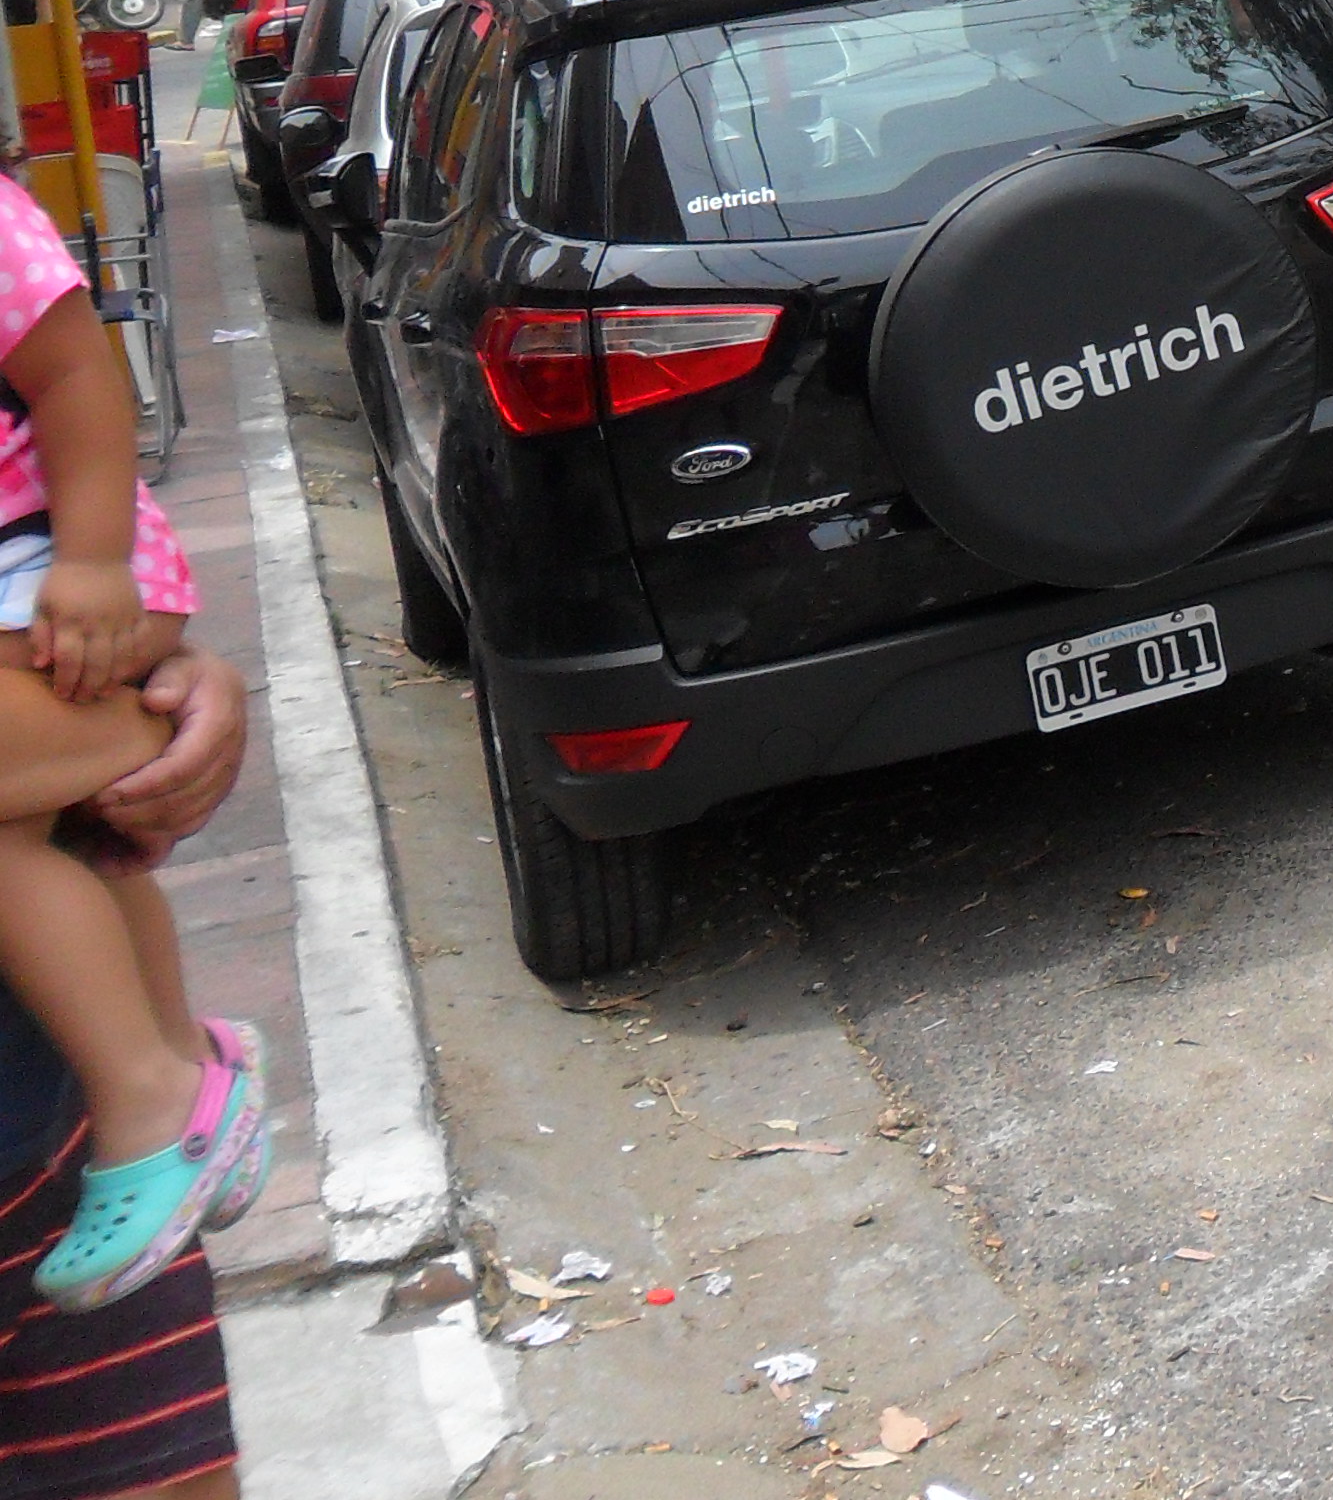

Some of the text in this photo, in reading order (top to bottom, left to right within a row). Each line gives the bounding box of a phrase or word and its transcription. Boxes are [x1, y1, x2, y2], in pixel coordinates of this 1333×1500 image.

[687, 186, 776, 214] dietrich
[974, 304, 1245, 432] dietrich
[688, 453, 734, 474] Ford
[1087, 621, 1158, 649] ARGENTINA
[1039, 628, 1217, 714] OJE 011
